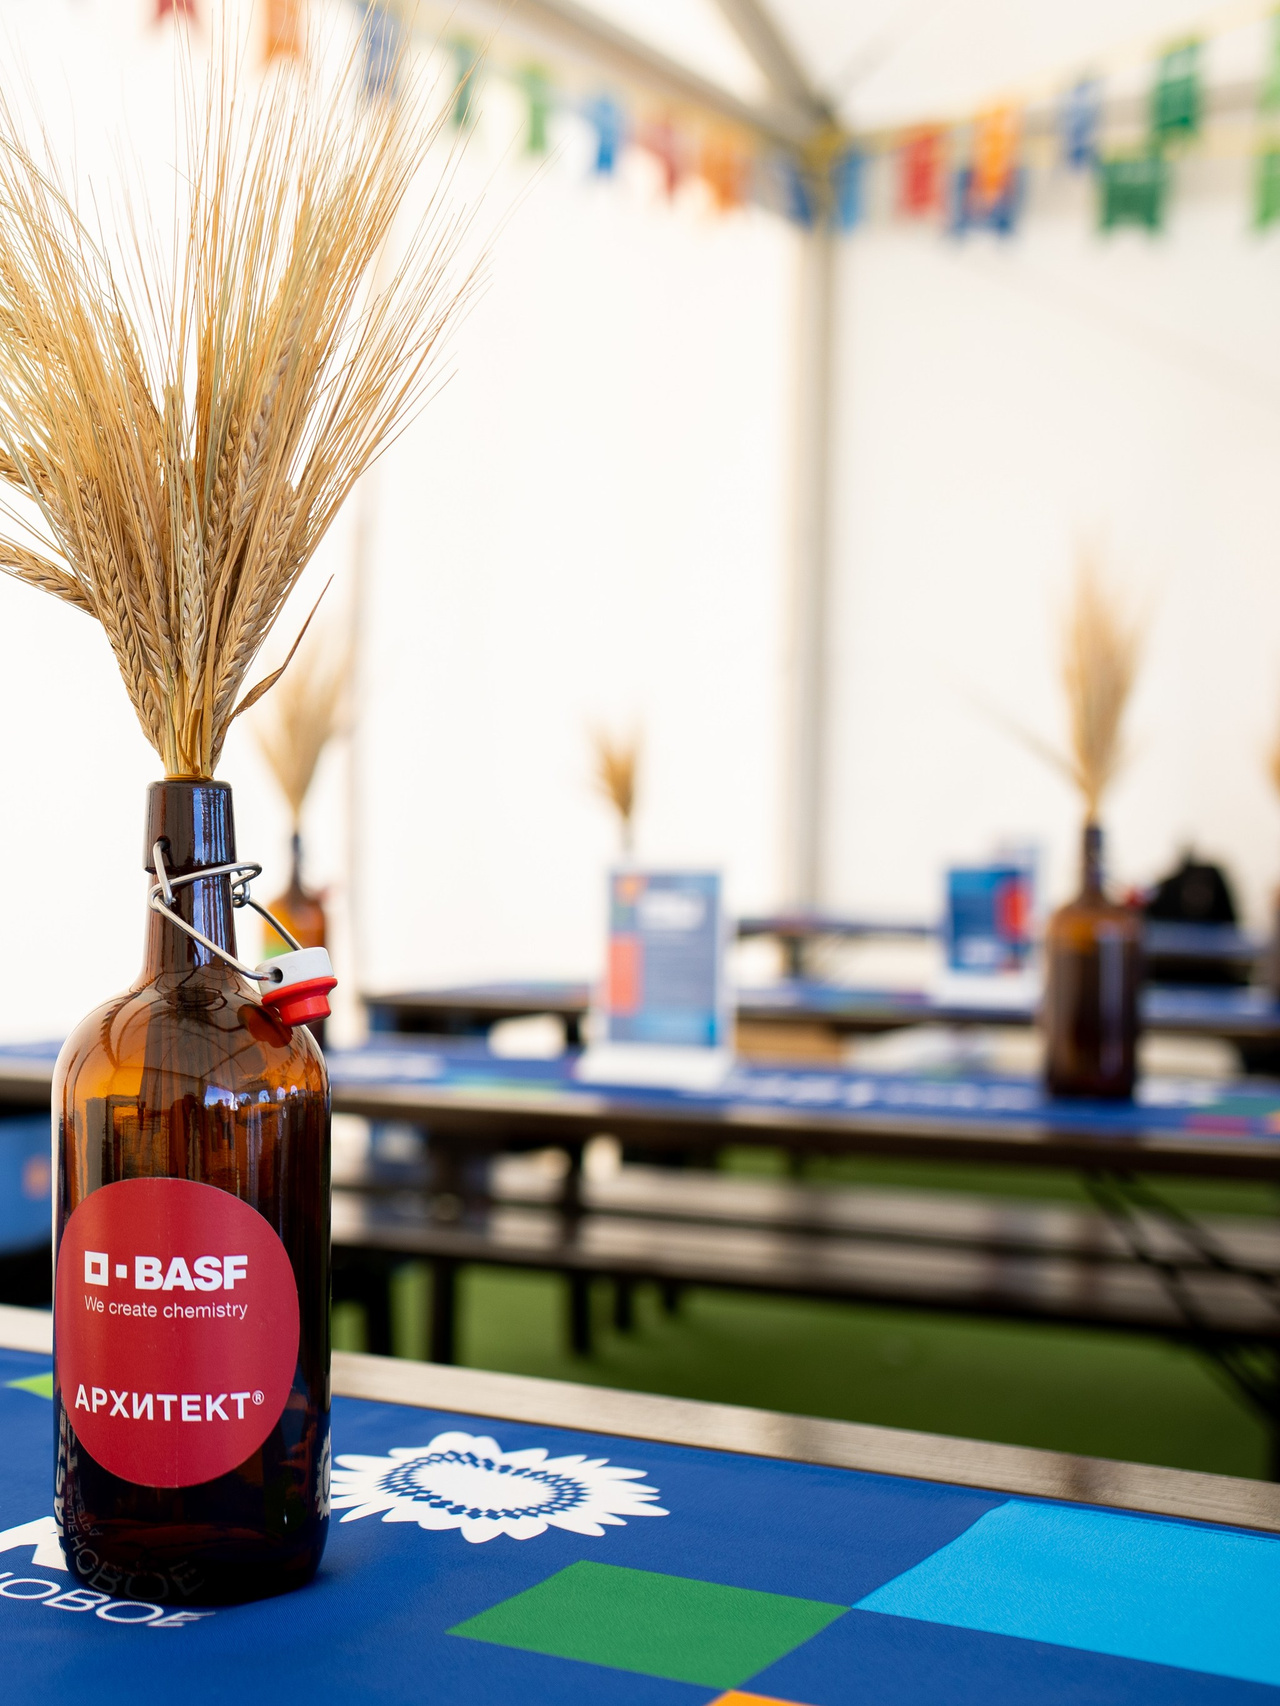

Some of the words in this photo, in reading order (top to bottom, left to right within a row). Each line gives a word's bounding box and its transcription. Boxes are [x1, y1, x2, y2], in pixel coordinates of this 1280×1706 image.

[135, 1255, 248, 1292] BASF
[85, 1295, 105, 1313] We
[109, 1302, 158, 1318] create
[163, 1303, 249, 1321] chemistry
